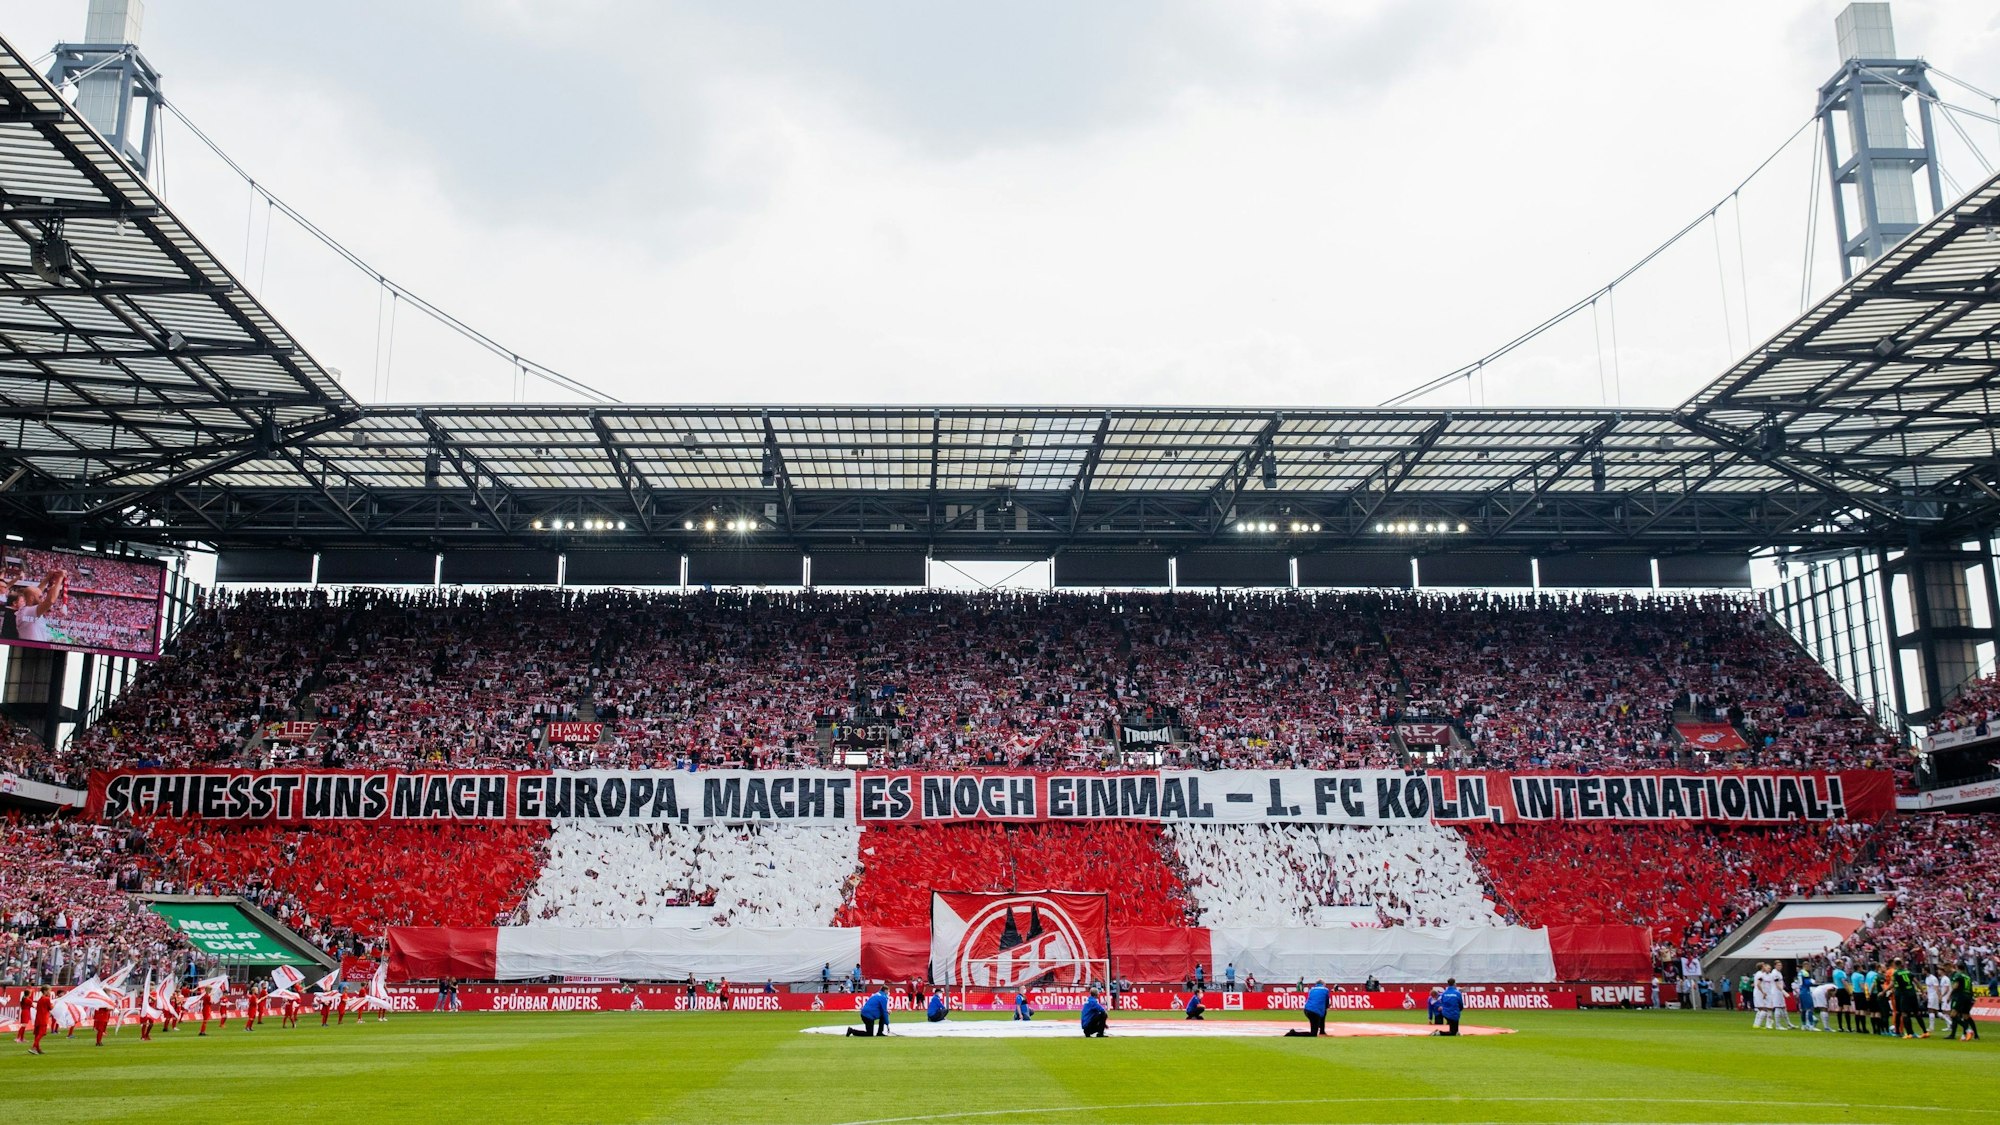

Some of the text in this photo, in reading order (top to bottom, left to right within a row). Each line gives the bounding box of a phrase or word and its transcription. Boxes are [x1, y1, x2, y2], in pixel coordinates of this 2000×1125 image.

[550, 723, 602, 738] HAWKS
[564, 733, 590, 742] KÖLN
[1124, 726, 1170, 743] TROIKA
[106, 775, 301, 820] SCHIESST
[303, 775, 388, 820] UNS
[391, 775, 508, 819] NACH
[517, 775, 690, 824] EUROPA,
[703, 778, 851, 819] MACHT
[861, 776, 913, 820] ES
[922, 776, 1037, 819] NOCH
[1048, 776, 1214, 818] EINMAL
[1314, 778, 1366, 817] FC
[1376, 770, 1504, 824] KÖLN,
[1510, 775, 1848, 820] INTERNATIONAL!
[178, 920, 229, 931] Mer
[493, 993, 601, 1010] SPÜRBAR ANDERS.
[1503, 994, 1552, 1009] ANDERS.
[1590, 985, 1646, 1003] REWE
[733, 995, 782, 1010] ANDERS.
